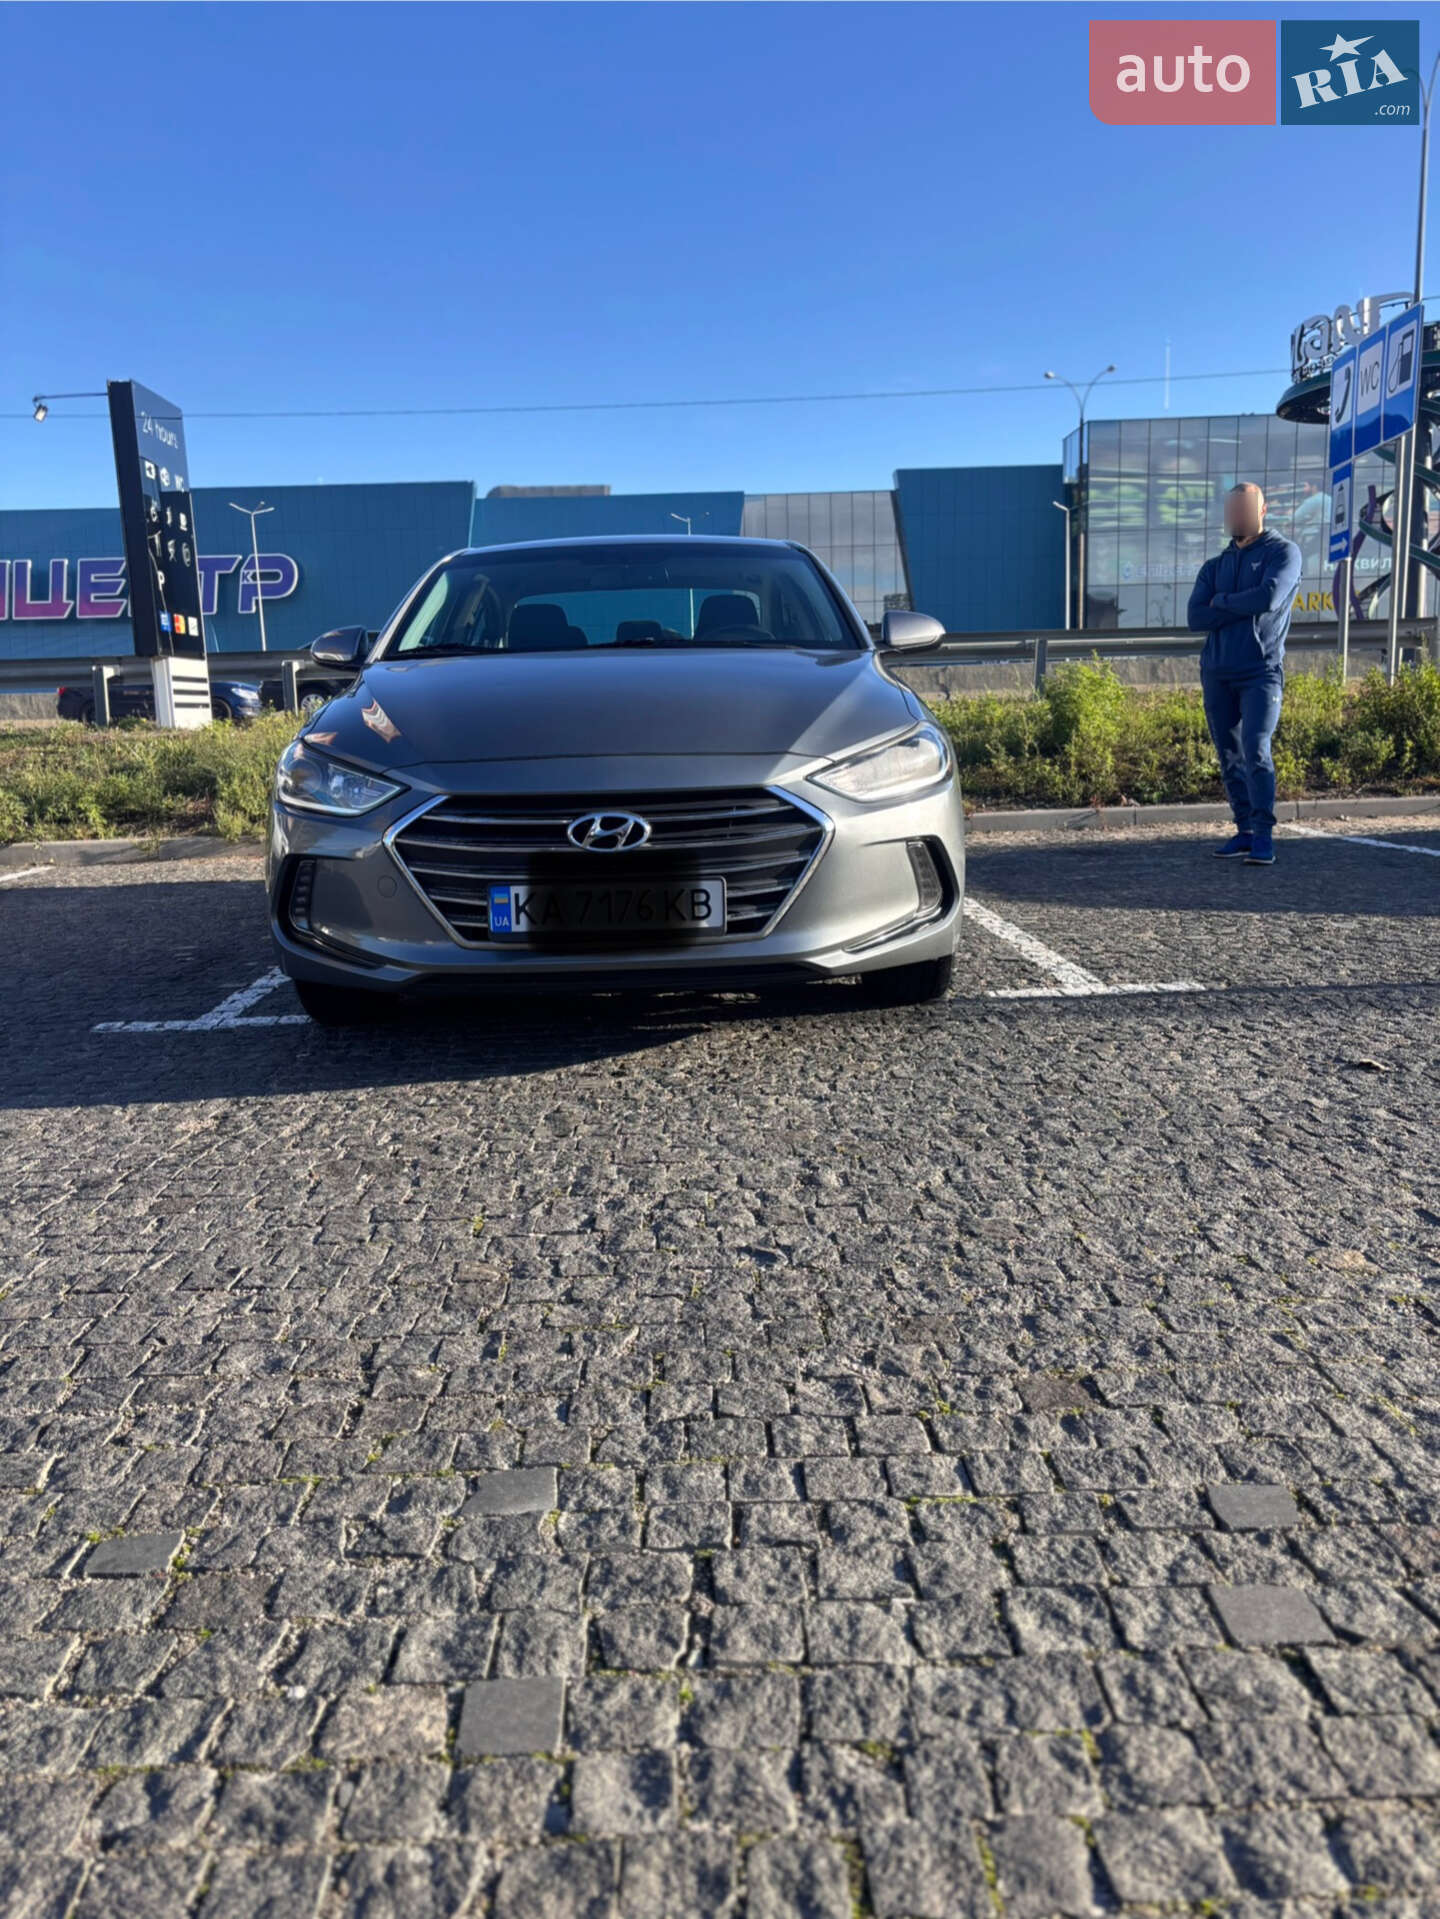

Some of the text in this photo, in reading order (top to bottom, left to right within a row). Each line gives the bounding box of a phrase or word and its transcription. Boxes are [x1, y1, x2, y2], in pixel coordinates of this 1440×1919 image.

[1360, 360, 1380, 396] WC
[141, 411, 153, 435] 24
[0, 553, 299, 620] ЦЕТР
[494, 916, 510, 927] UA
[514, 888, 712, 926] KA 7176 KB
